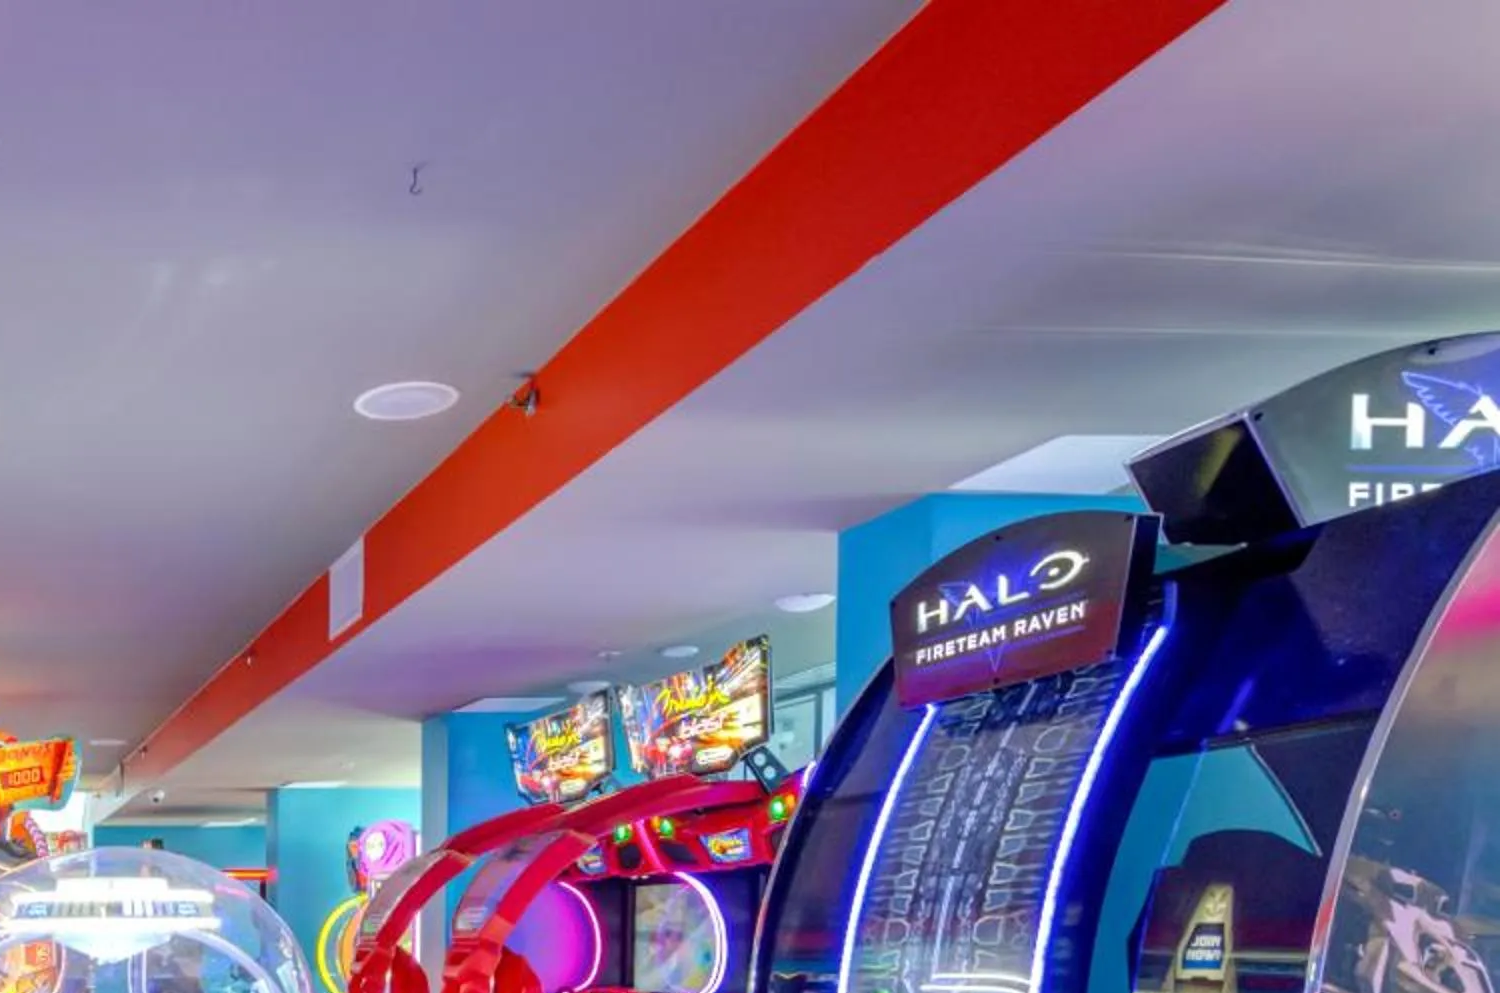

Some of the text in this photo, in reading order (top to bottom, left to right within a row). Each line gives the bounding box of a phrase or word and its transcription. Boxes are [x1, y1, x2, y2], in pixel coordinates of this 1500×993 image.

[1349, 482, 1443, 507] FIR
[917, 551, 1090, 635] HALO
[915, 601, 1087, 665] FIRETEAM RAVEN
